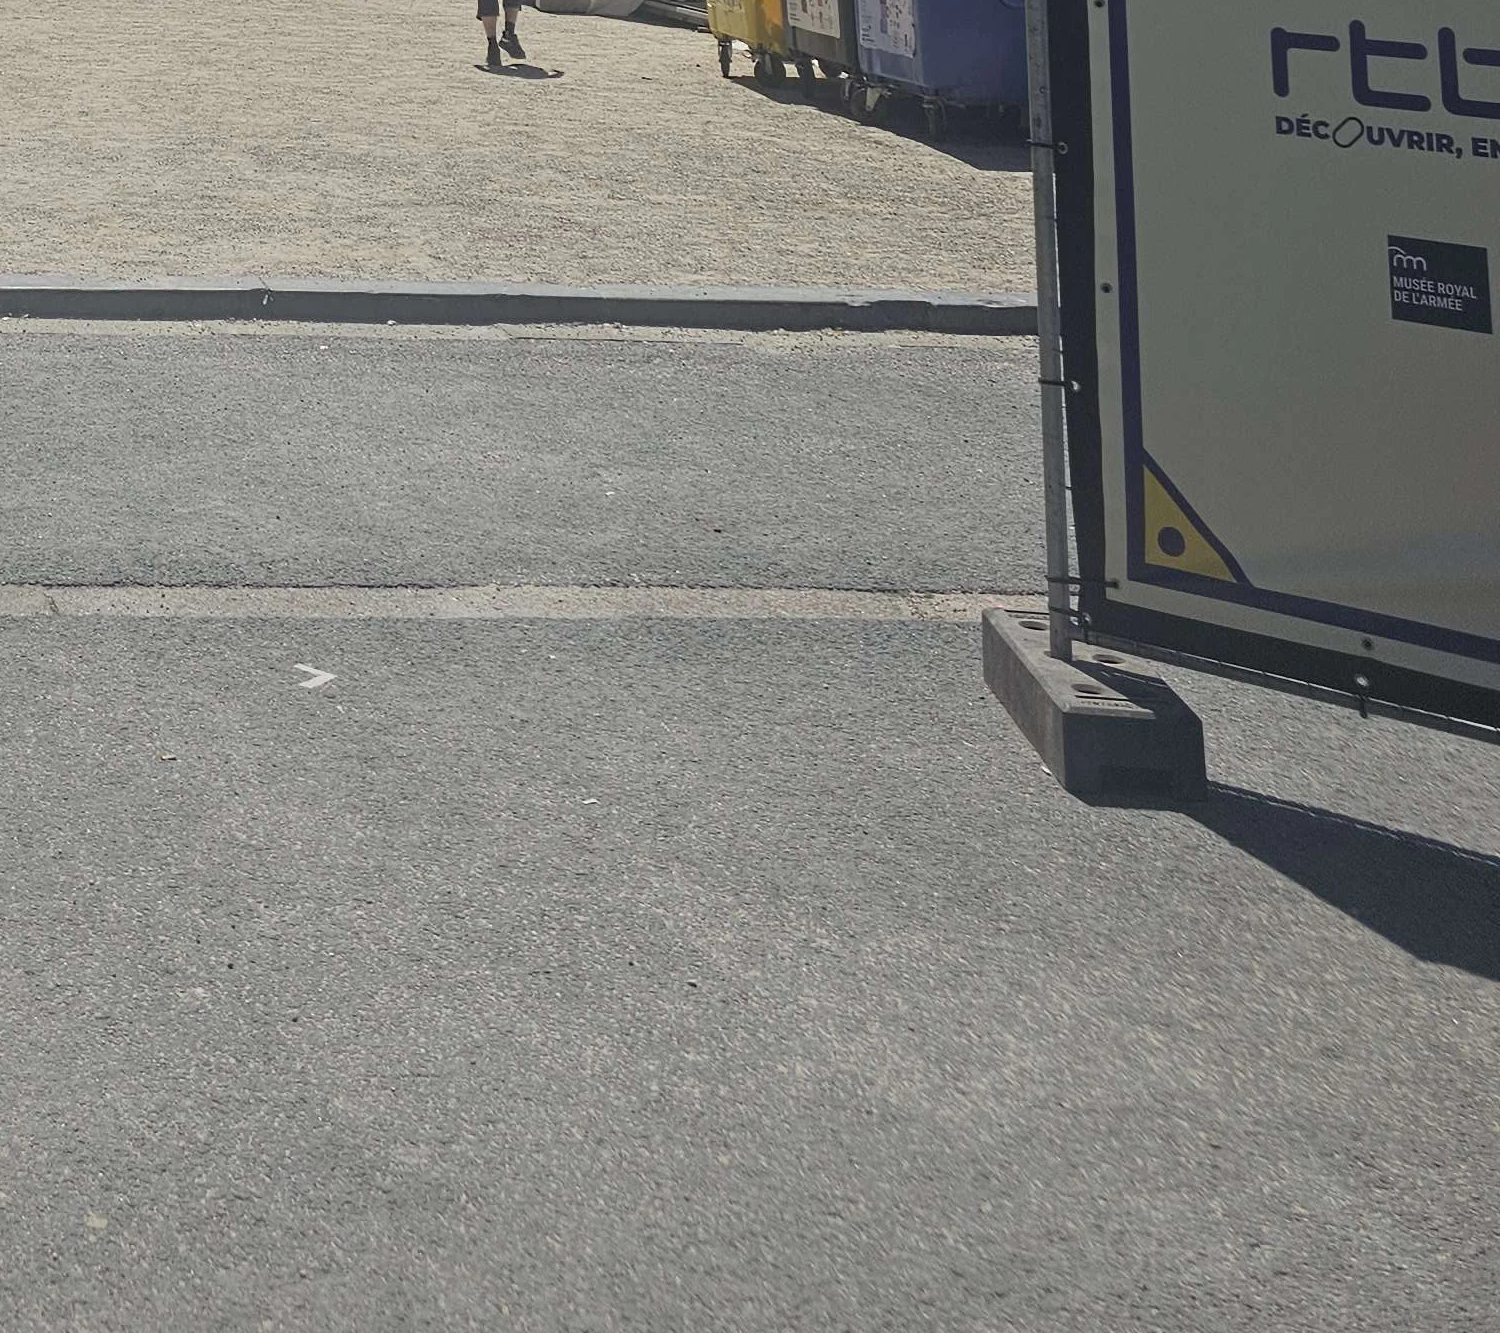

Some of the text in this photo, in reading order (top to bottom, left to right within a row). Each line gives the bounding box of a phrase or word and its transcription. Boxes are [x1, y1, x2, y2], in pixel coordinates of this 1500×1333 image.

[1275, 114, 1463, 159] DÉCOUVRIR,
[1393, 275, 1477, 299] MUSÉE ROYAL
[1394, 290, 1463, 311] DE L'ARMÉE
